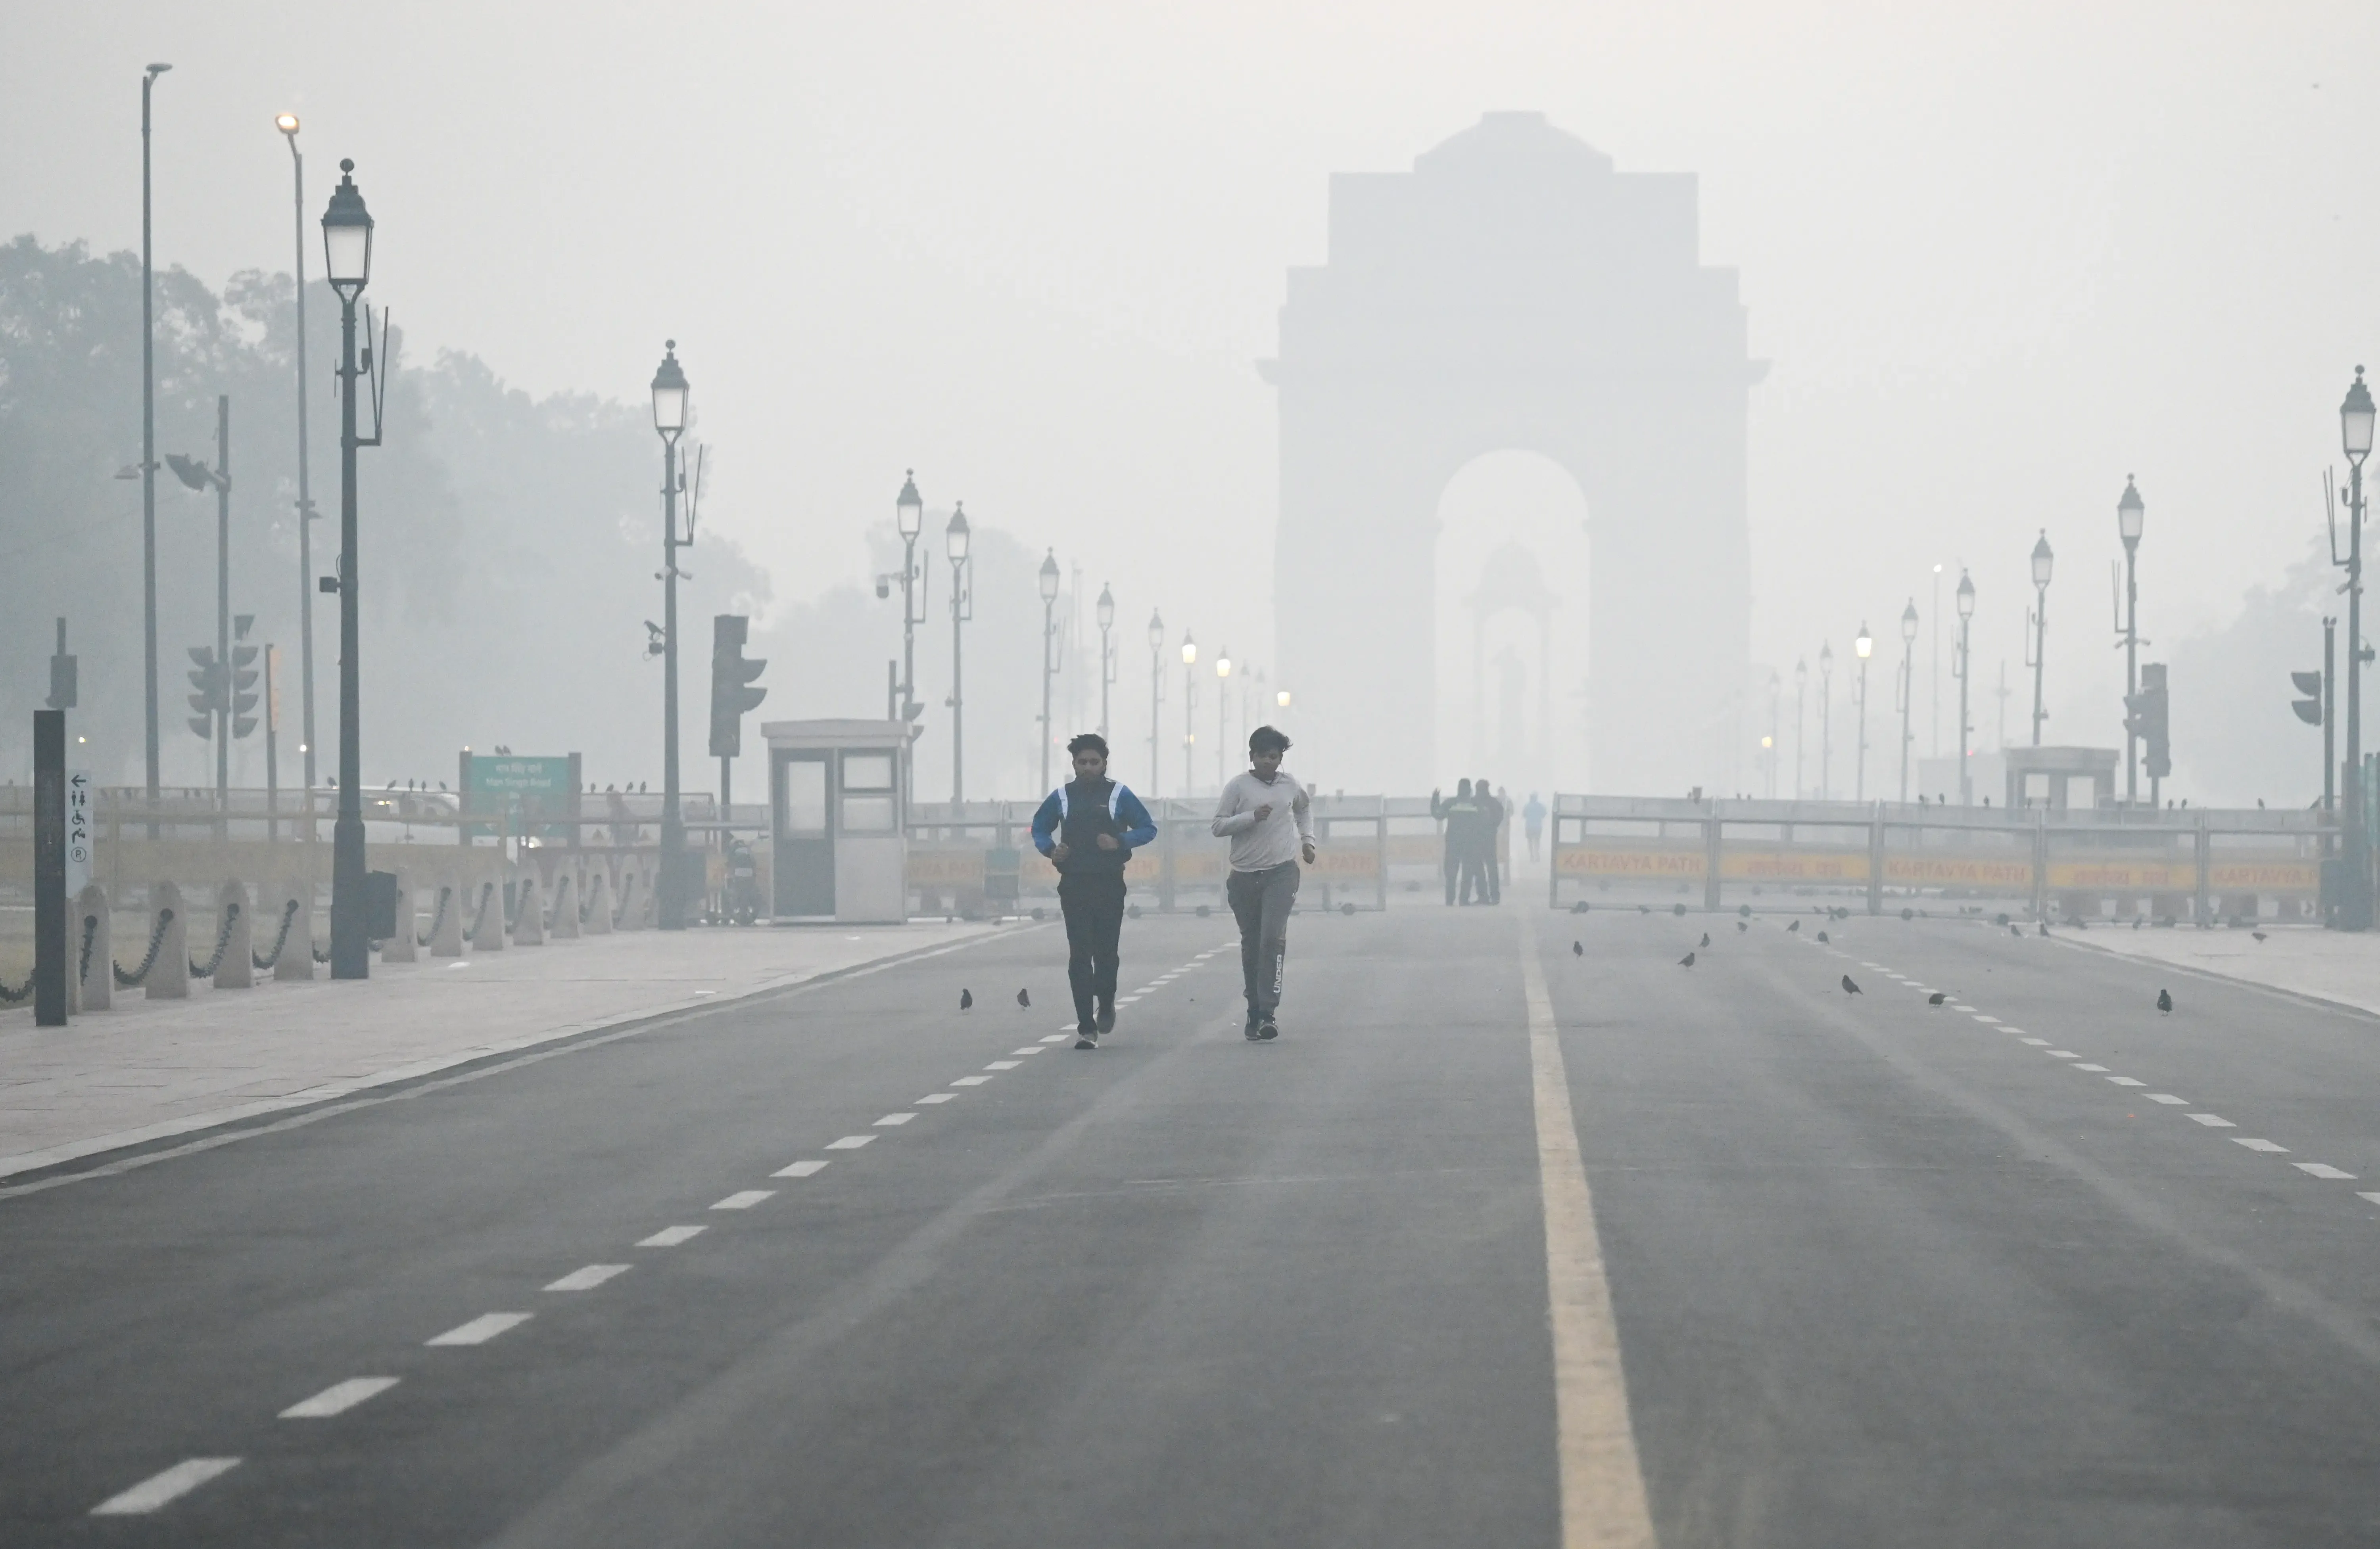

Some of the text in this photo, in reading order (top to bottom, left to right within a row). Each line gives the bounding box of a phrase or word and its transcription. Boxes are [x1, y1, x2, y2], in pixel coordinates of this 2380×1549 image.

[1564, 854, 1701, 872] KARTAVYA PATH
[1888, 861, 2025, 881] KARTAVYA PATH
[2214, 868, 2301, 884] KARTAVYA
[1274, 954, 1282, 993] UNDER
